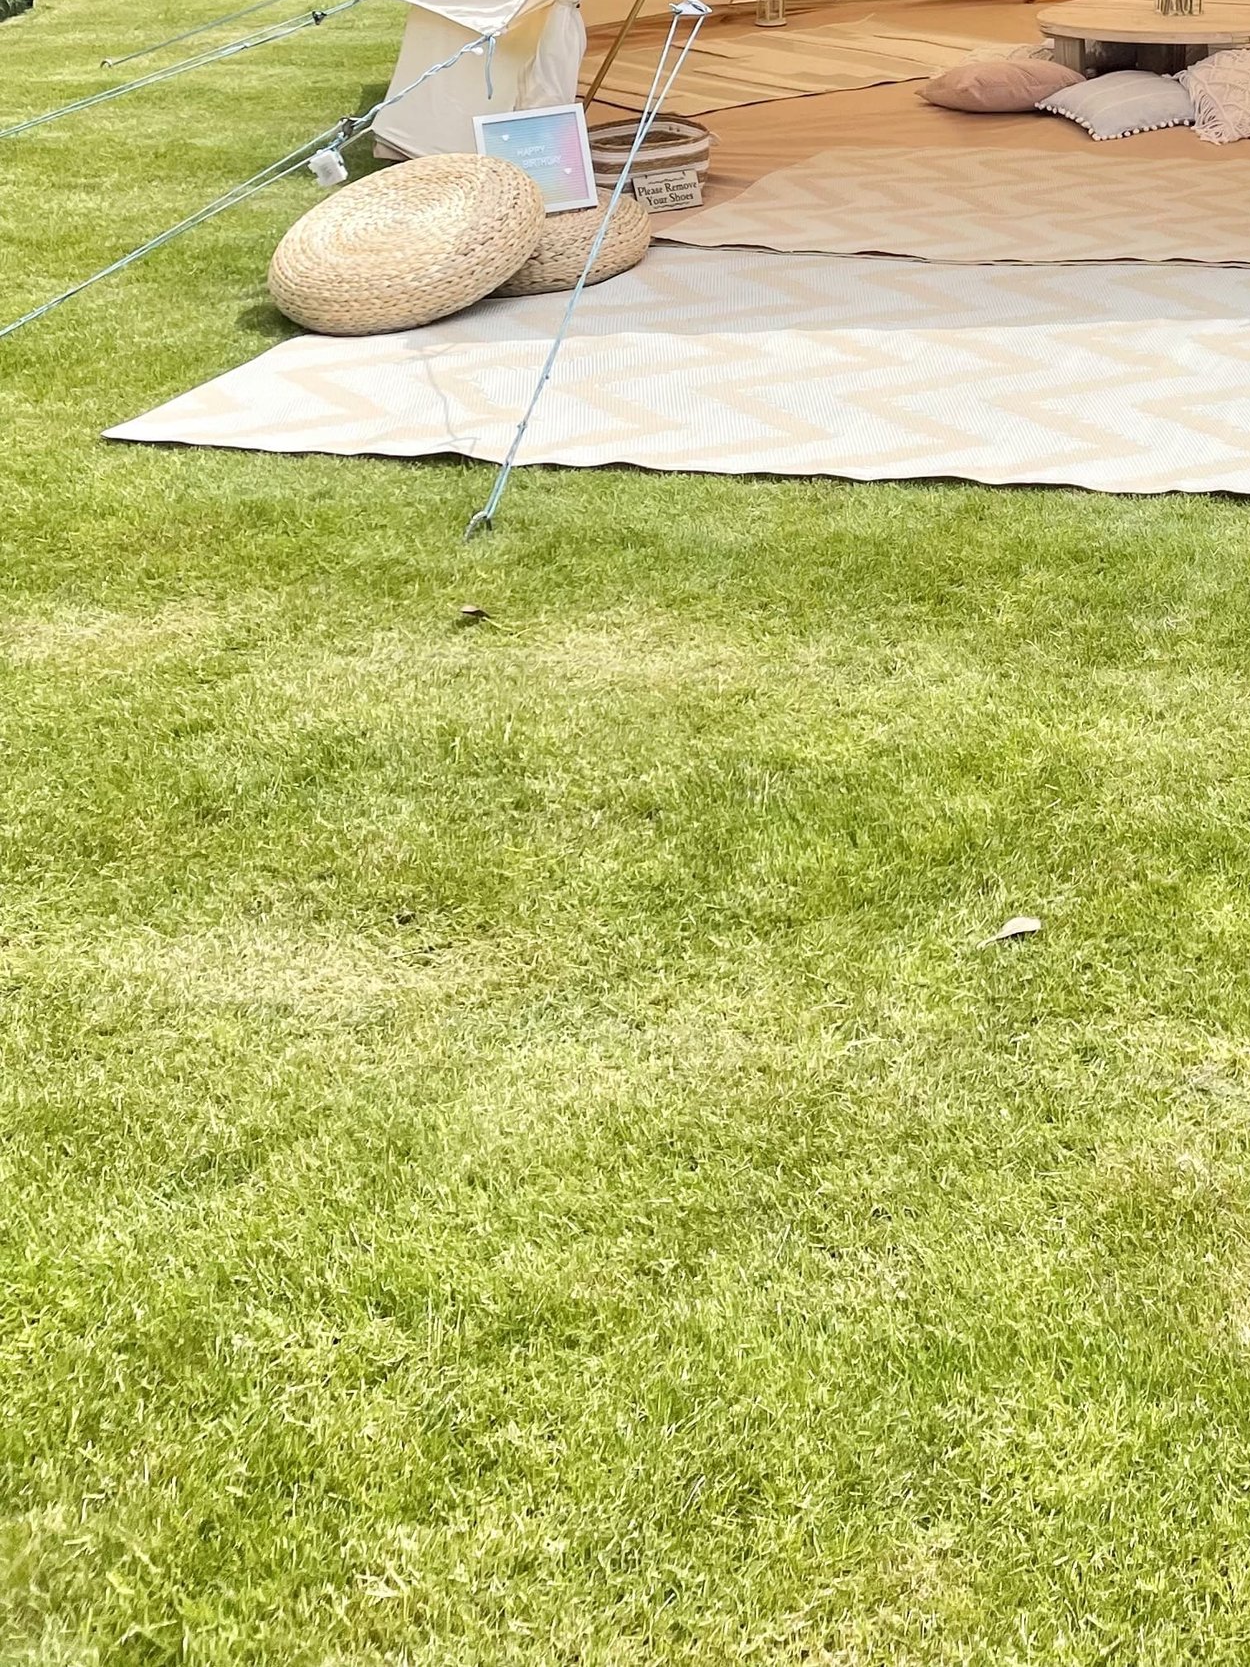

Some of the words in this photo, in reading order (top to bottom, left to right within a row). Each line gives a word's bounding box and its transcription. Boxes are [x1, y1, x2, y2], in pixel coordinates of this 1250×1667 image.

[517, 145, 545, 156] HAPPY
[522, 155, 562, 169] BIRTHDAY
[637, 186, 663, 197] Please
[664, 182, 697, 192] Remove
[646, 196, 668, 206] Your
[669, 192, 694, 202] Shoes
